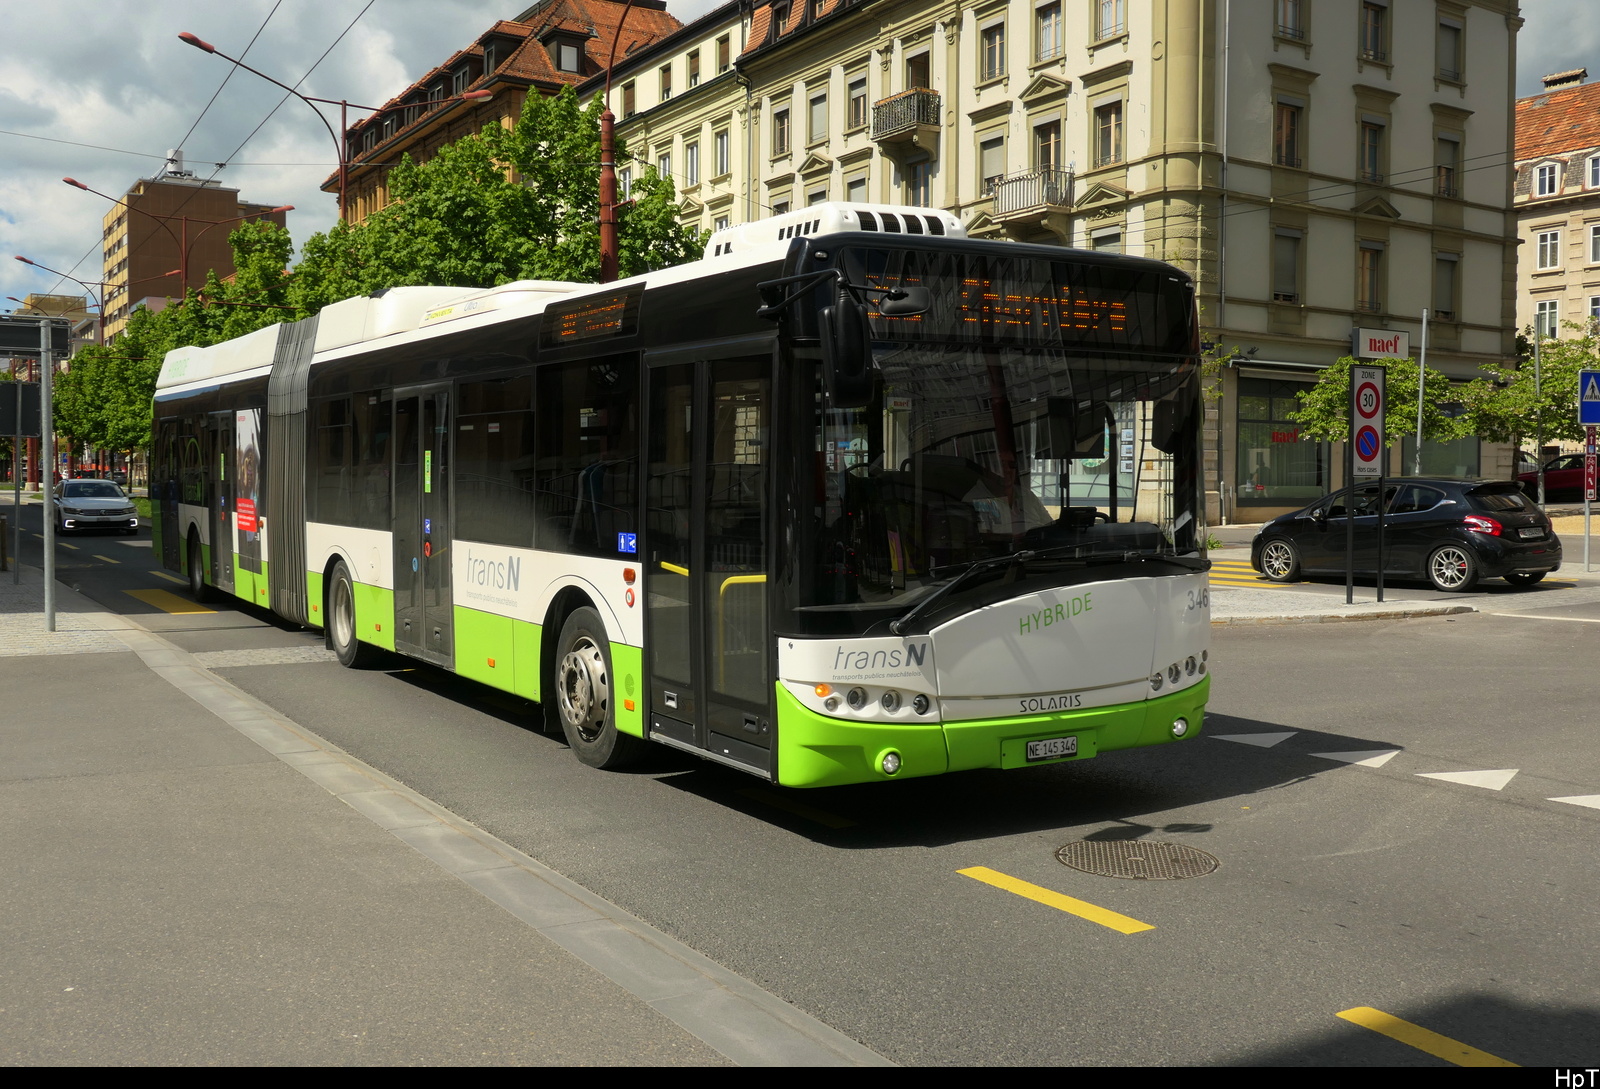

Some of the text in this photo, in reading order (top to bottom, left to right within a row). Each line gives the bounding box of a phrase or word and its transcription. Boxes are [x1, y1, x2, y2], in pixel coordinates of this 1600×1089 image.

[1368, 334, 1400, 354] naef
[1361, 371, 1376, 380] ZONE
[1362, 393, 1374, 408] 30
[1271, 428, 1299, 444] naef
[1357, 465, 1367, 473] Hors
[1187, 587, 1209, 611] 346
[1019, 592, 1093, 636] HYBRIDE
[864, 672, 885, 680] publics
[1019, 694, 1082, 713] SOLARIS
